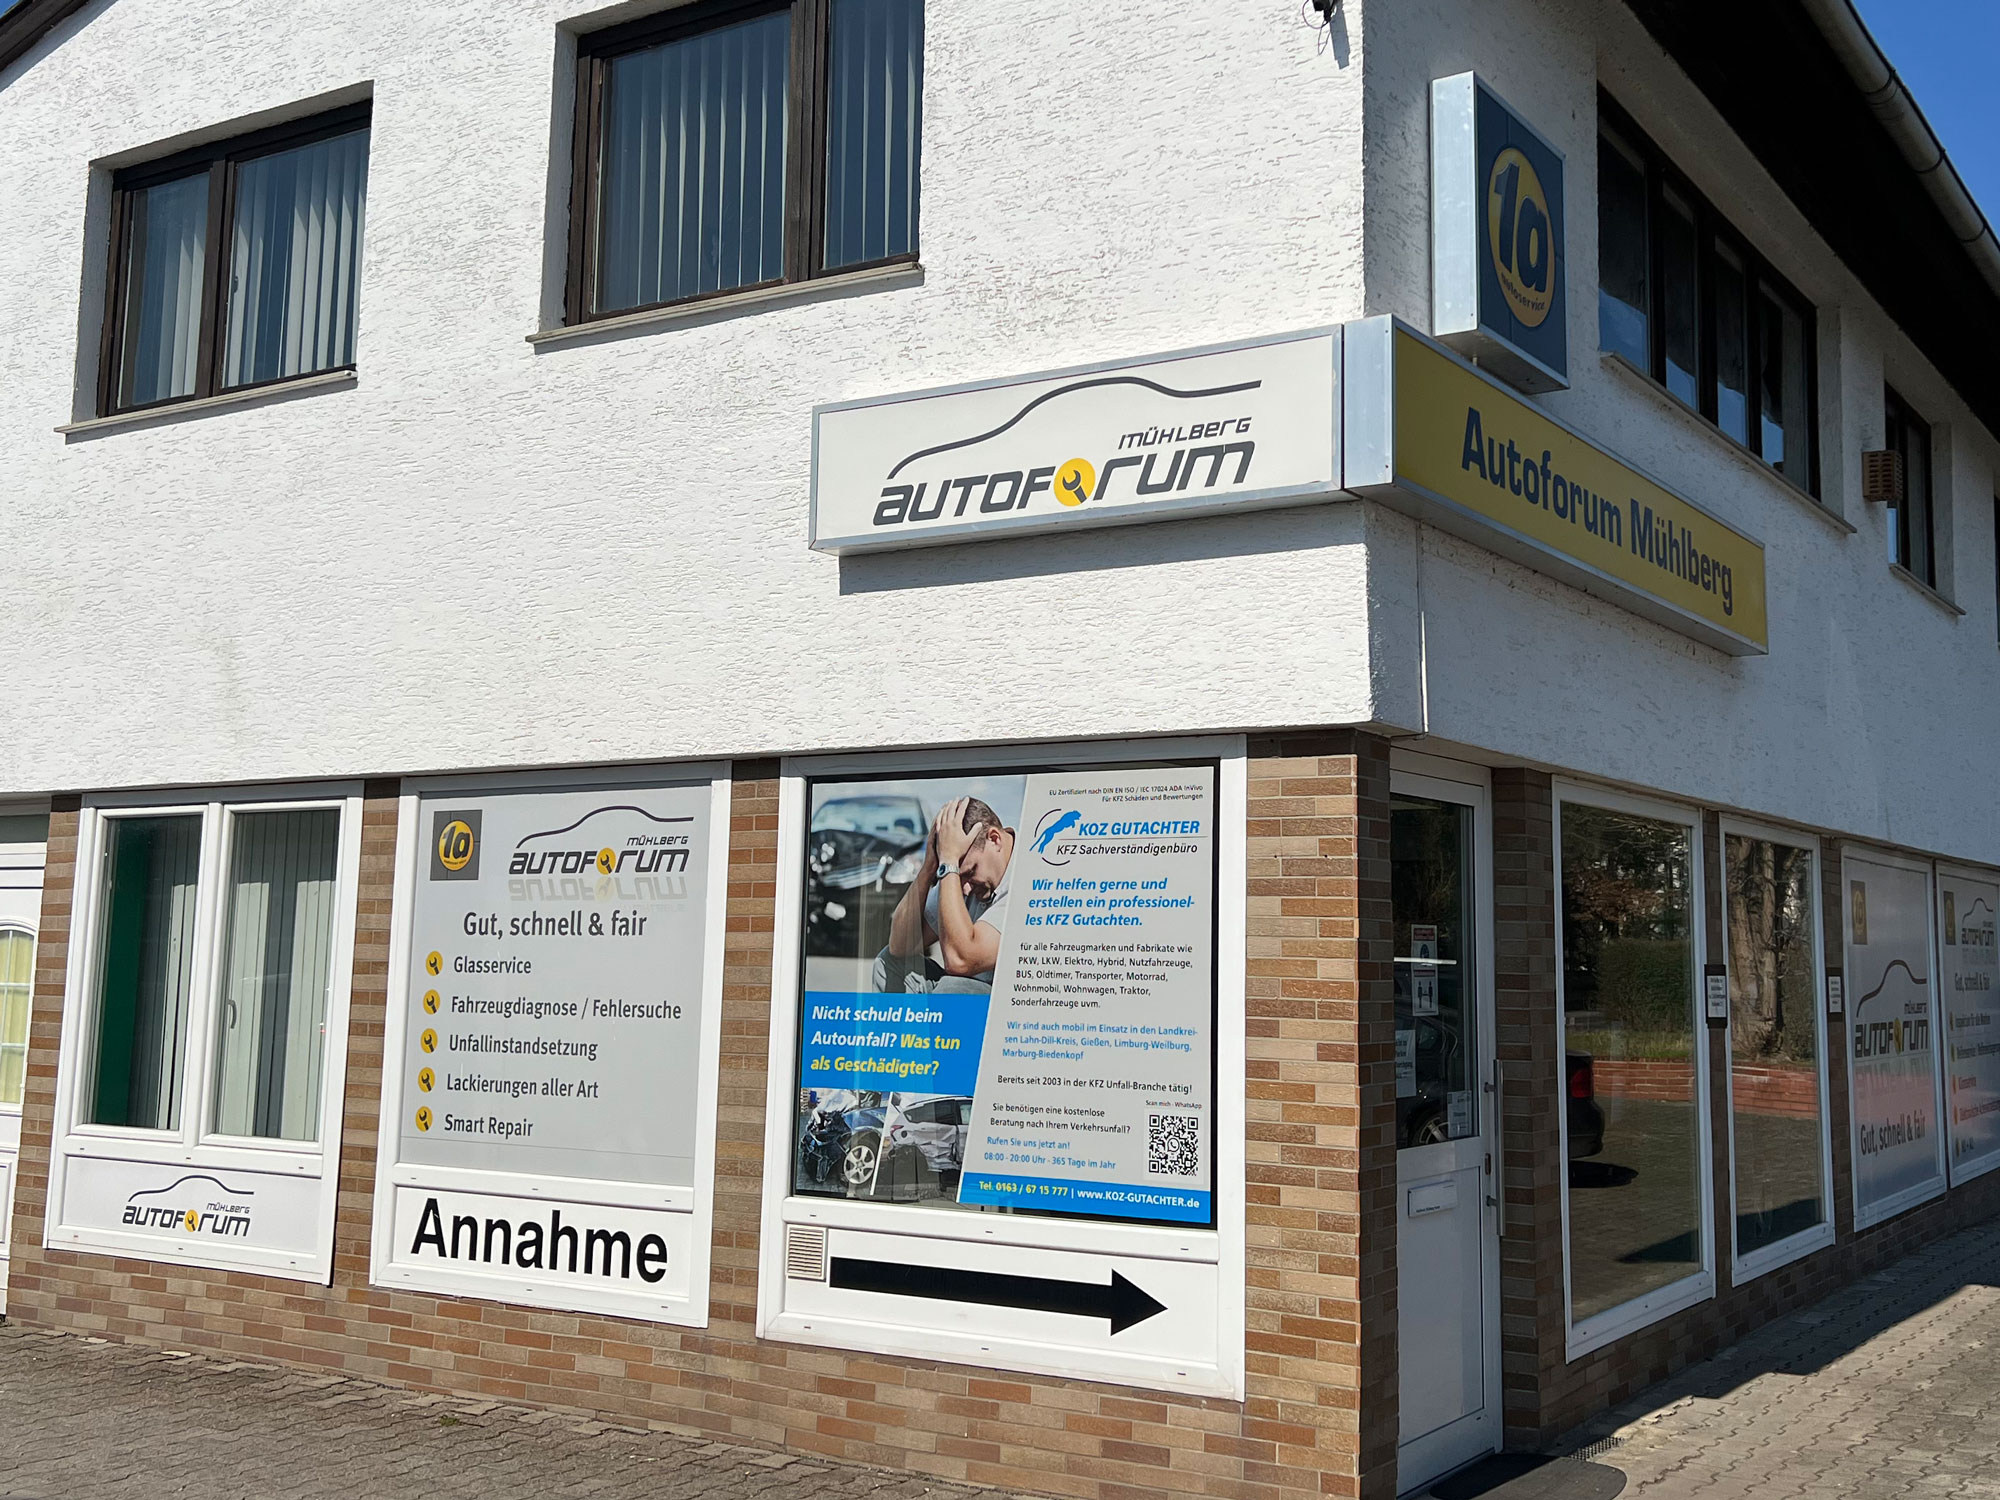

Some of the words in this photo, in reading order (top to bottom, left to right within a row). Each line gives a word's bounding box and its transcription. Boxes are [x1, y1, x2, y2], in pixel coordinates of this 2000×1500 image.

[1462, 406, 1622, 547] Autoforum
[1631, 499, 1734, 617] Mühlberg
[1079, 823, 1109, 836] KOZ
[1111, 821, 1200, 836] GUTACHTER
[1057, 845, 1078, 855] KFZ
[1079, 843, 1198, 856] Sachverständigenbüro
[1032, 879, 1054, 891] Wir
[1056, 878, 1096, 891] helfen
[1100, 881, 1138, 893] gerne
[1141, 878, 1168, 890] und
[1029, 897, 1082, 908] erstellen
[1086, 897, 1106, 908] ein
[1109, 896, 1195, 910] professionel-
[463, 911, 503, 940] Gut,
[510, 911, 583, 938] schnell
[589, 913, 604, 937] &
[611, 909, 647, 937] fair
[1025, 914, 1043, 926] les
[1045, 914, 1070, 925] KFZ
[1073, 915, 1143, 926] Gutachten.
[1020, 943, 1032, 951] für
[1034, 943, 1048, 951] alle
[1050, 943, 1116, 953] Fahrzeugmarken
[1118, 944, 1134, 952] und
[1137, 944, 1175, 953] Fabrikate
[1177, 945, 1193, 953] wie
[454, 956, 532, 975] Glasservice
[1019, 957, 1039, 966] PKW,
[1042, 958, 1062, 966] LKW,
[1065, 958, 1095, 967] Elektro,
[1097, 958, 1127, 967] Hybrid,
[1129, 958, 1193, 969] Nutzfahrzeuge,
[1016, 971, 1034, 979] BUS,
[1037, 971, 1073, 980] Oldtimer,
[1075, 971, 1124, 981] Transporter,
[1127, 973, 1168, 982] Motorrad,
[1014, 984, 1061, 993] Wohnmobil,
[1064, 985, 1117, 996] Wohnwagen,
[1120, 987, 1151, 996] Traktor,
[451, 996, 577, 1020] Fahrzeugdiagnose
[582, 998, 589, 1019] /
[592, 999, 681, 1021] Fehlersuche
[1011, 998, 1079, 1009] Sonderfahrzeuge
[812, 1006, 850, 1023] Nicht
[854, 1007, 903, 1023] schuld
[905, 1009, 943, 1024] beim
[1007, 1022, 1021, 1030] Wir
[1023, 1022, 1039, 1030] sind
[1041, 1023, 1060, 1031] auch
[1062, 1024, 1085, 1032] mobil
[1100, 1025, 1128, 1034] Einsatz
[1130, 1025, 1138, 1034] in
[1140, 1026, 1156, 1035] den
[1159, 1026, 1198, 1036] Landkrei-
[449, 1035, 599, 1062] Unfallinstandsetzung
[811, 1030, 897, 1049] Autounfall?
[900, 1034, 931, 1050] Was
[934, 1036, 960, 1051] tun
[1020, 1036, 1079, 1047] Lahn-Dill-Kreis,
[1081, 1038, 1112, 1048] Gießen,
[1115, 1039, 1192, 1052] Limburg-Weilburg,
[1003, 1049, 1084, 1061] Marburg-Biedenkopf
[811, 1055, 831, 1072] als
[834, 1056, 939, 1078] Geschädigter?
[447, 1073, 537, 1098] Lackierungen
[541, 1078, 573, 1098] aller
[577, 1080, 599, 1099] Art
[998, 1076, 1025, 1085] Bereits
[1027, 1077, 1041, 1085] seit
[1043, 1077, 1062, 1086] 2003
[1064, 1078, 1071, 1086] in
[1073, 1079, 1087, 1087] der
[1089, 1080, 1104, 1088] KFZ
[1106, 1080, 1167, 1092] Unfall-Branche
[1169, 1084, 1193, 1095] tätig!
[993, 1104, 1004, 1112] Sie
[1006, 1105, 1044, 1114] benötigen
[1064, 1107, 1105, 1117] kostenlose
[444, 1114, 483, 1134] Smart
[488, 1118, 533, 1142] Repair
[990, 1118, 1025, 1129] Beratung
[1027, 1120, 1044, 1129] nach
[1046, 1121, 1069, 1130] Ihrem
[1071, 1122, 1131, 1133] Verkehrsunfall?
[1861, 1124, 1878, 1157] Gut,
[1879, 1113, 1906, 1150] schnell
[1907, 1113, 1913, 1142] &
[1914, 1110, 1925, 1139] fair
[987, 1137, 1009, 1145] Rufen
[1011, 1138, 1022, 1146] Sie
[1038, 1140, 1055, 1149] jetzt
[985, 1153, 1005, 1161] 08:00
[1010, 1154, 1030, 1163] 20:00
[1032, 1156, 1046, 1164] Uhr
[1052, 1157, 1066, 1165] 365
[1068, 1158, 1086, 1168] Tage
[1088, 1160, 1097, 1168] im
[1100, 1160, 1116, 1169] Jahr
[979, 1181, 995, 1191] Tel.
[996, 1182, 1017, 1192] 0163
[1026, 1184, 1037, 1194] 67
[1040, 1185, 1050, 1195] 15
[1052, 1187, 1068, 1196] 777
[1077, 1190, 1200, 1208] www.KOZ-GUTACHTER.de
[411, 1198, 668, 1284] Annahme
